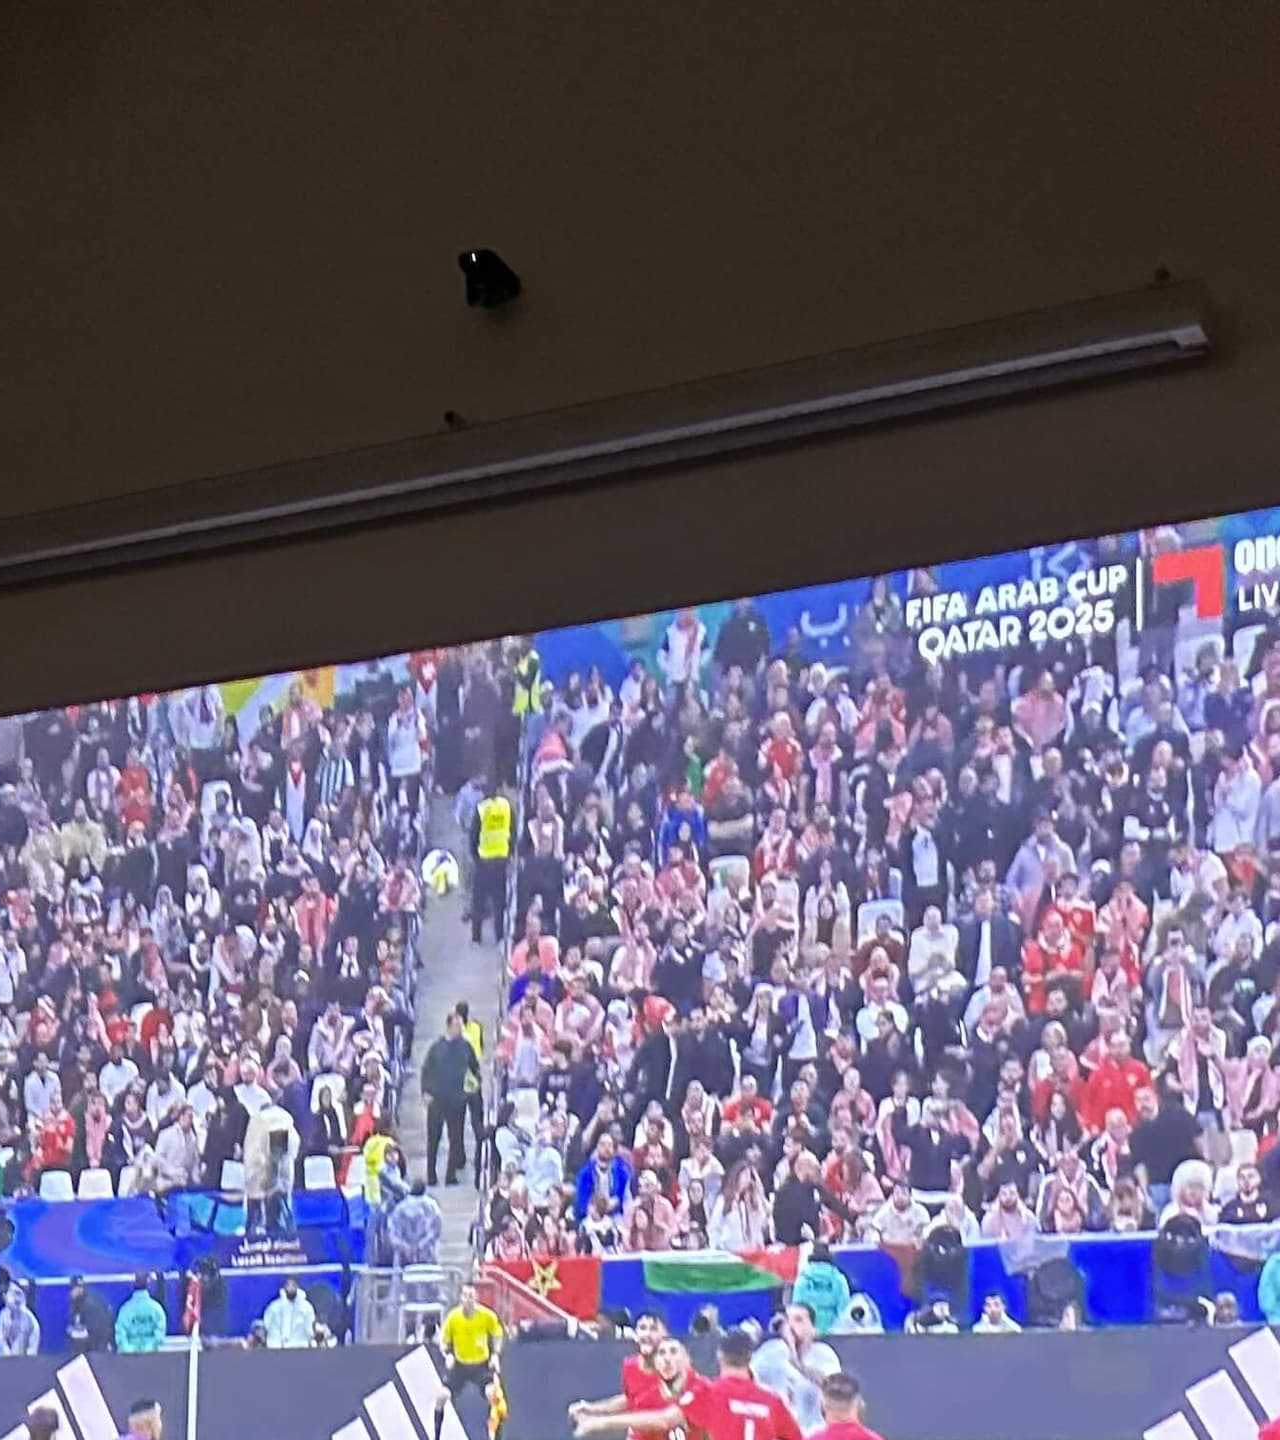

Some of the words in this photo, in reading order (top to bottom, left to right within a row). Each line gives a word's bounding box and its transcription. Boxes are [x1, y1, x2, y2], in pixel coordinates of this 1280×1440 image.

[906, 591, 968, 627] FIFA
[975, 577, 1059, 615] ARAB
[1067, 564, 1128, 601] CUP
[918, 615, 1021, 666] QATAR
[1028, 598, 1115, 643] 2025
